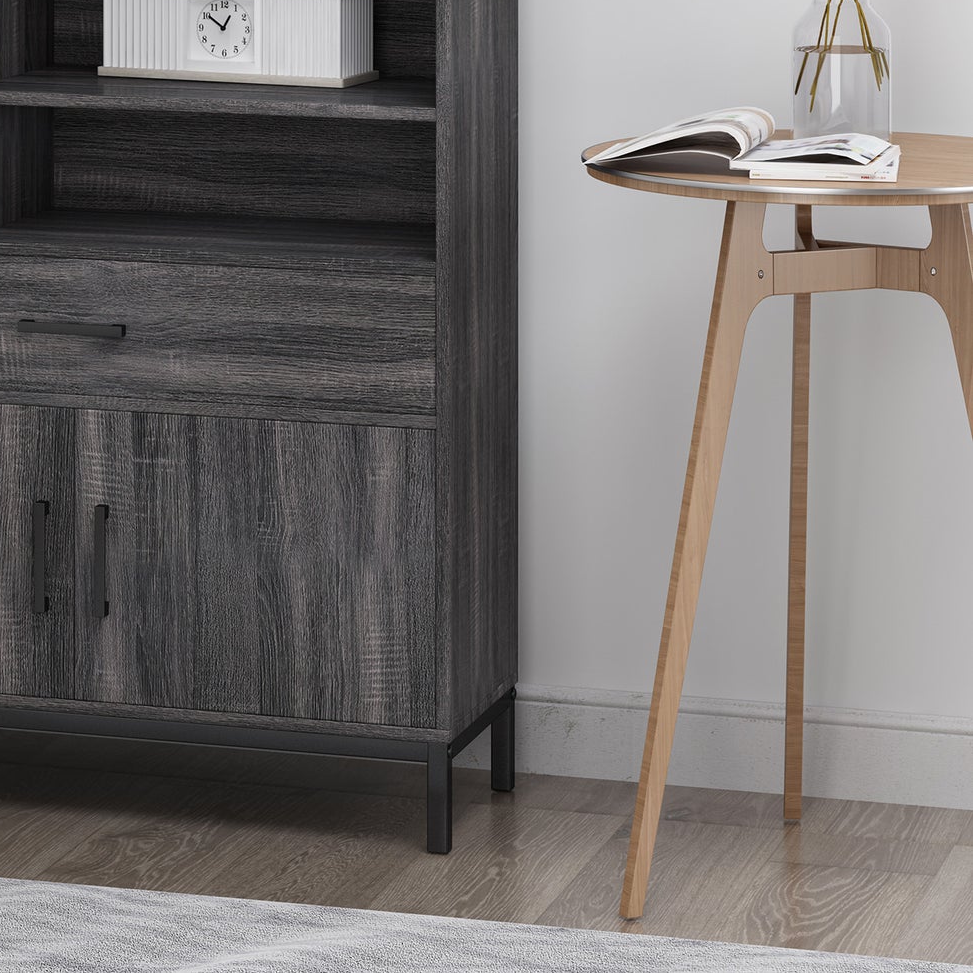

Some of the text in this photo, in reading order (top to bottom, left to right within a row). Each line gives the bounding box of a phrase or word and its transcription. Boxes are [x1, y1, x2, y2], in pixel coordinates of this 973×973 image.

[210, 3, 218, 11] 11
[220, 0, 229, 9] 12
[234, 4, 238, 12] 1
[202, 11, 211, 20] 10
[241, 13, 247, 22] 2
[198, 23, 204, 32] 9
[244, 26, 250, 34] 3
[201, 35, 208, 43] 8
[241, 36, 247, 45] 4
[210, 44, 216, 53] 7
[221, 48, 227, 57] 6
[233, 45, 239, 53] 5
